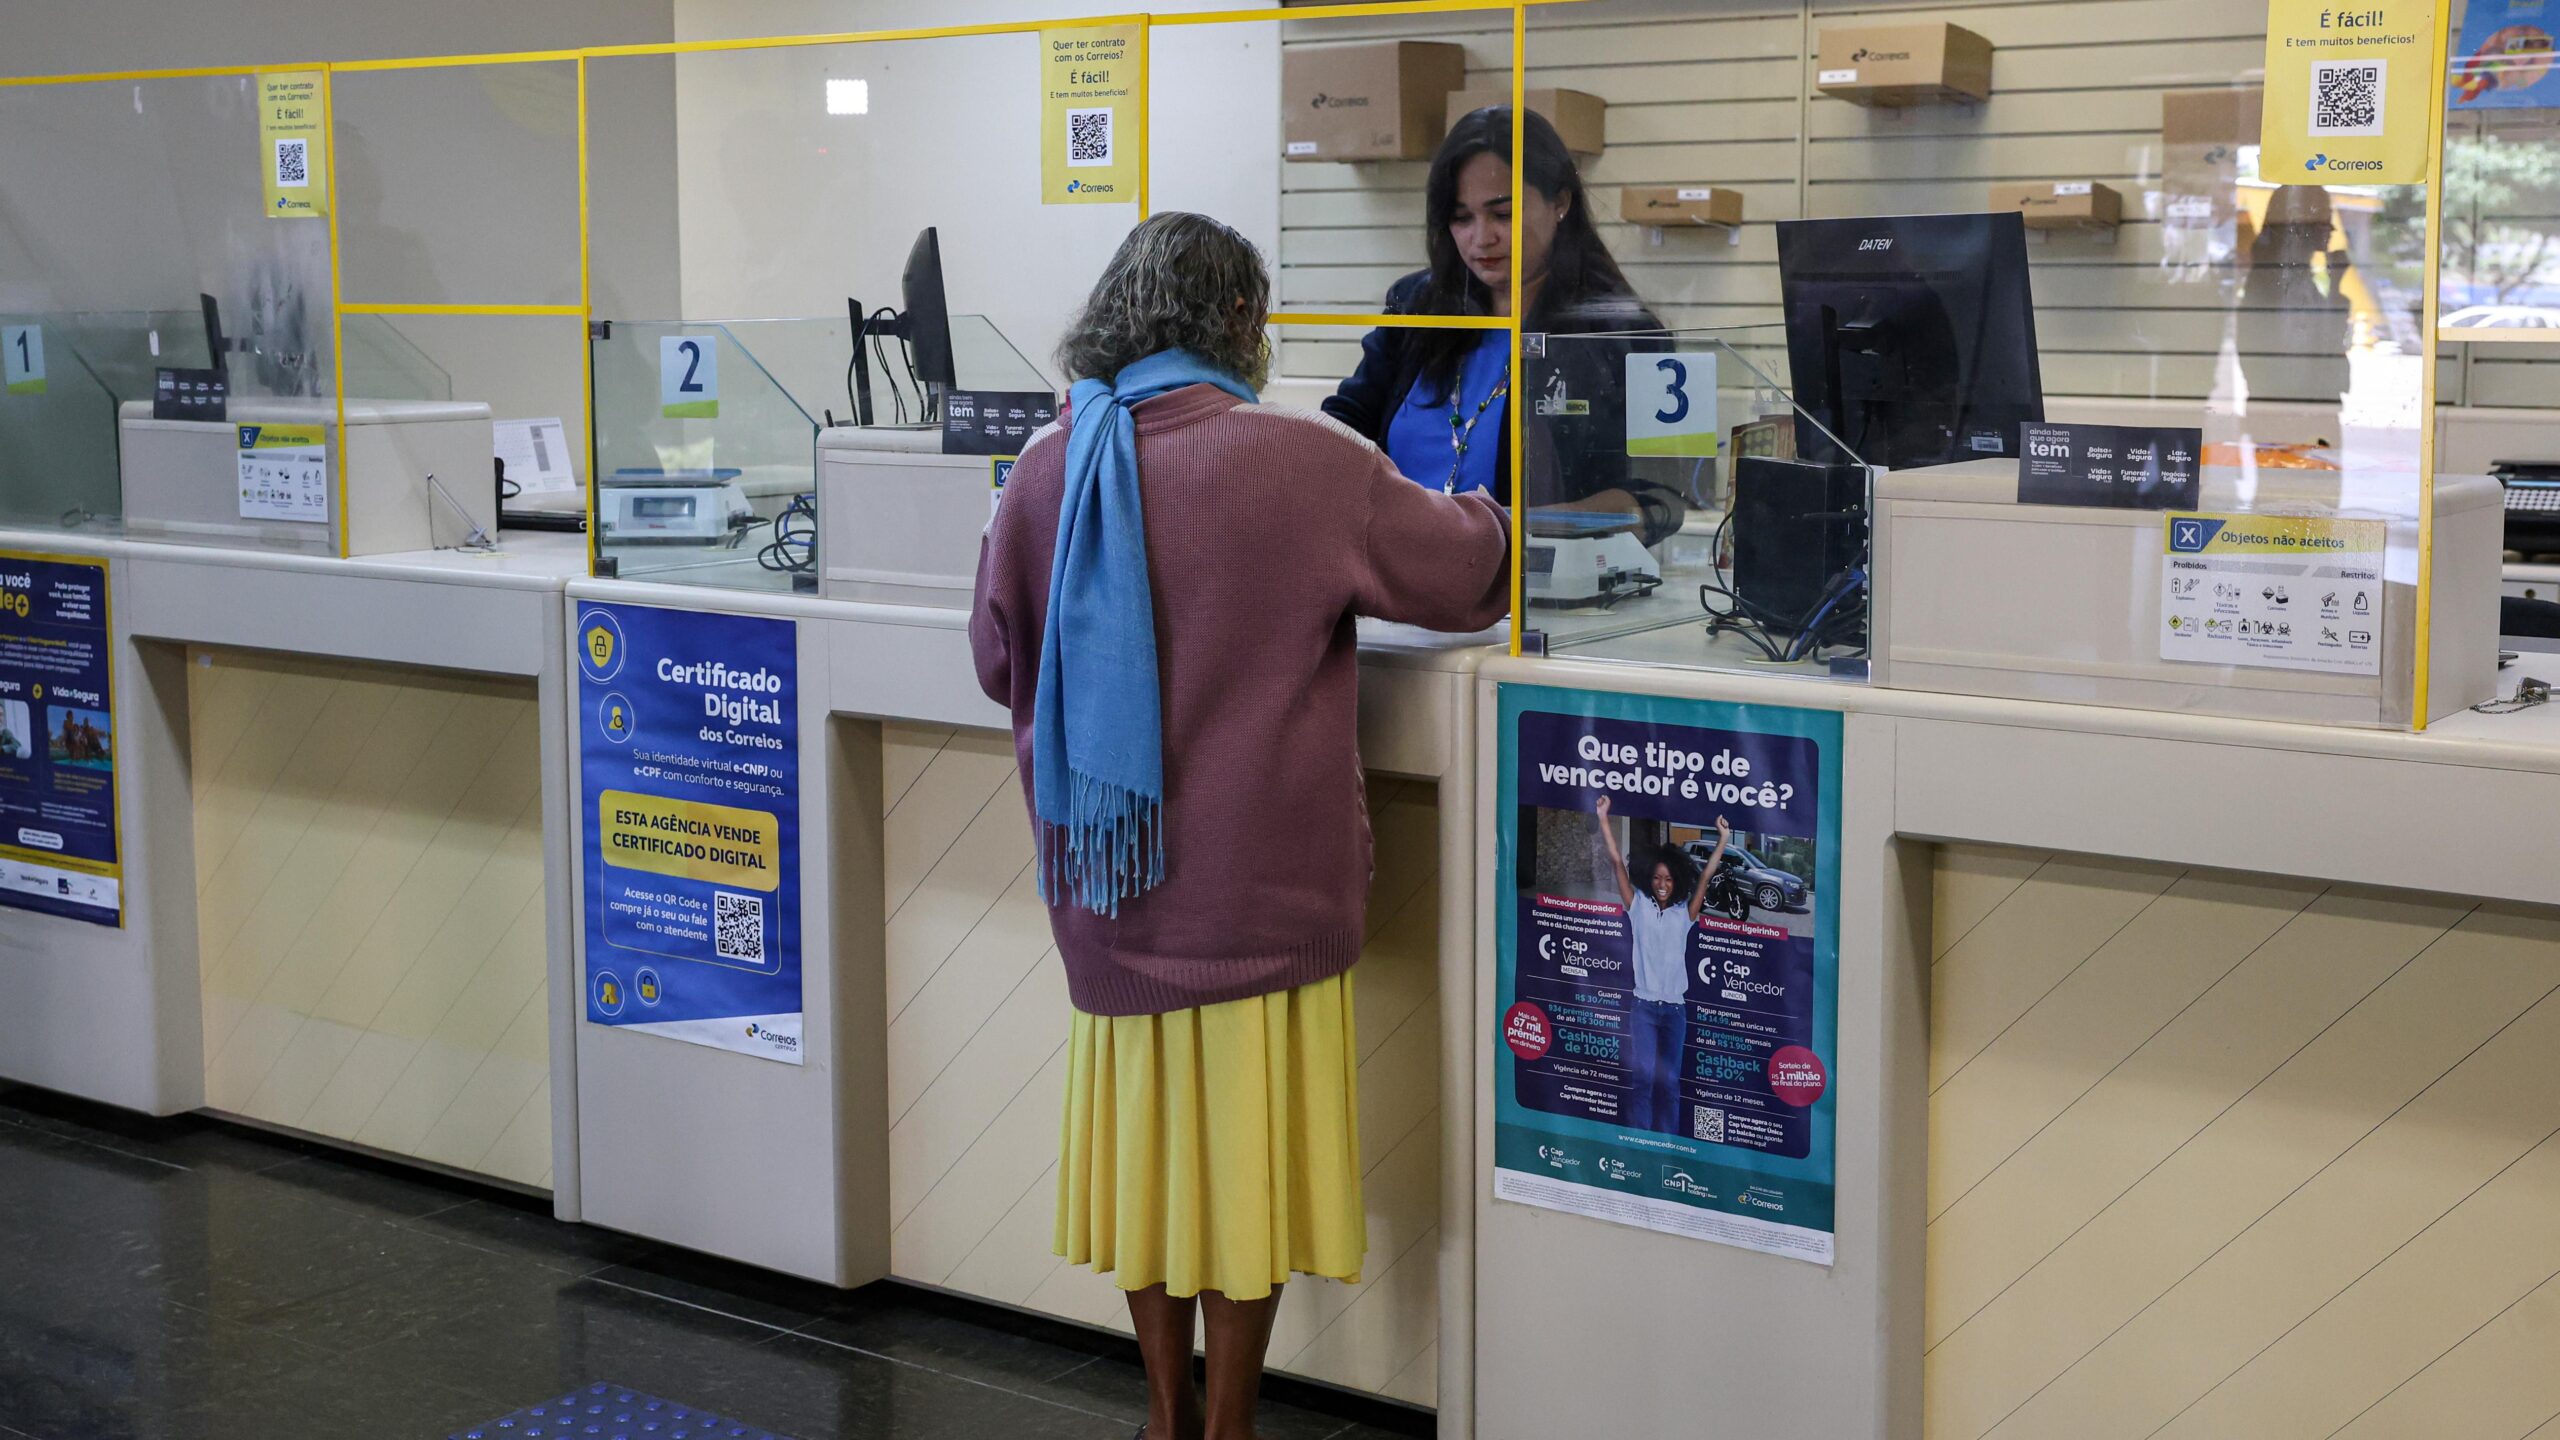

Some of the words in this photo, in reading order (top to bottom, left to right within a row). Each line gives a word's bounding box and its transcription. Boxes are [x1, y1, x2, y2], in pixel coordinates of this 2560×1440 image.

[2321, 9, 2331, 28] É
[2337, 11, 2383, 28] fácil!
[1053, 41, 1073, 50] Quer
[1091, 38, 1125, 47] contrato
[2286, 38, 2292, 47] E
[2296, 39, 2316, 47] tem
[2320, 36, 2353, 46] muitos
[1055, 54, 1072, 62] com
[1086, 51, 1123, 61] Correios?
[1869, 51, 1910, 62] Correios
[1071, 69, 1077, 84] É
[1081, 71, 1109, 83] fácil!
[290, 82, 313, 90] contrato
[277, 107, 282, 119] É
[2329, 159, 2383, 170] Correios
[1081, 184, 1113, 193] Correios
[1858, 239, 1893, 250] DATEN
[17, 330, 30, 372] 1
[678, 341, 702, 392] 2
[1655, 359, 1689, 423] 3
[949, 405, 974, 417] tem
[2029, 442, 2069, 458] tem
[2221, 532, 2268, 545] Objetos
[2273, 535, 2295, 546] não
[2300, 536, 2344, 548] aceitos
[2173, 562, 2207, 570] Proibidos
[2341, 571, 2375, 580] Restritos
[657, 658, 781, 694] Certificado
[705, 693, 781, 726] Digital
[700, 727, 722, 742] dos
[726, 731, 783, 750] Correios
[633, 749, 650, 761] Sua
[652, 752, 699, 767] identidade
[702, 758, 731, 772] virtual
[734, 763, 768, 777] e-CNPJ
[770, 769, 782, 779] ou
[1578, 735, 1638, 765] Que
[1645, 742, 1704, 776] tipo
[1711, 749, 1750, 777] de
[634, 766, 661, 778] e-CPF
[663, 772, 683, 781] com
[684, 773, 723, 787] conforto
[726, 779, 731, 788] e
[734, 781, 784, 796] segurança.
[1539, 763, 1673, 796] vencedor
[1680, 773, 1698, 798] é
[1705, 781, 1794, 810] você?
[616, 810, 648, 828] ESTA
[651, 814, 711, 838] AGÊNCIA
[713, 824, 761, 845] VENDE
[613, 833, 706, 860] CERTIFICADO
[710, 848, 766, 870] DIGITAL
[625, 887, 655, 901] Acesse
[657, 894, 662, 902] o
[663, 893, 677, 905] QR
[679, 895, 701, 909] Code
[703, 902, 708, 910] e
[1543, 896, 1577, 910] Vencedor
[1578, 902, 1617, 913] poupador
[610, 901, 642, 917] compre
[644, 905, 651, 917] já
[653, 909, 659, 917] o
[661, 910, 676, 920] seu
[678, 912, 689, 921] ou
[692, 913, 708, 925] fale
[1532, 910, 1562, 922] Economiza
[1563, 915, 1572, 923] um
[1574, 916, 1606, 928] pouquinho
[1607, 920, 1623, 928] todo
[636, 920, 655, 931] com
[656, 924, 662, 932] o
[663, 924, 708, 941] atendente
[1705, 918, 1741, 932] Vencedor
[1742, 924, 1780, 937] ligeirinho
[1562, 937, 1588, 954] Cap
[1563, 952, 1622, 971] Vencedor
[1723, 961, 1750, 977] Cap
[1562, 967, 1586, 975] MENSAL
[1723, 976, 1784, 996] Vencedor
[1598, 991, 1622, 999] Guarde
[1514, 1017, 1525, 1028] 67
[1527, 1021, 1541, 1032] mil
[760, 1030, 796, 1046] Correios
[1508, 1027, 1546, 1044] prêmios
[1559, 1029, 1620, 1048] Cashback
[1565, 1043, 1580, 1053] de
[1584, 1045, 1619, 1060] 100%
[1696, 1052, 1760, 1073] Cashback
[1553, 1064, 1579, 1075] Vigência
[1598, 1072, 1619, 1081] meses.
[1696, 1066, 1713, 1077] de
[1716, 1069, 1744, 1082] 50%
[1780, 1072, 1785, 1080] 1
[1786, 1072, 1821, 1081] milhão
[1803, 1080, 1822, 1088] plano.
[1696, 1089, 1723, 1100] Vigência
[1724, 1093, 1733, 1101] de
[1734, 1094, 1741, 1102] 12
[1743, 1096, 1765, 1106] meses.
[1618, 1134, 1697, 1154] www.capvencedor.com.br
[1550, 1148, 1564, 1157] Cap
[1551, 1155, 1581, 1167] Vencedor
[1611, 1159, 1625, 1169] Cap
[1611, 1166, 1642, 1179] Vencedor
[1664, 1178, 1682, 1188] CNP
[1687, 1183, 1709, 1192] Seguros
[1687, 1188, 1707, 1197] holding
[1752, 1197, 1784, 1211] Correios
